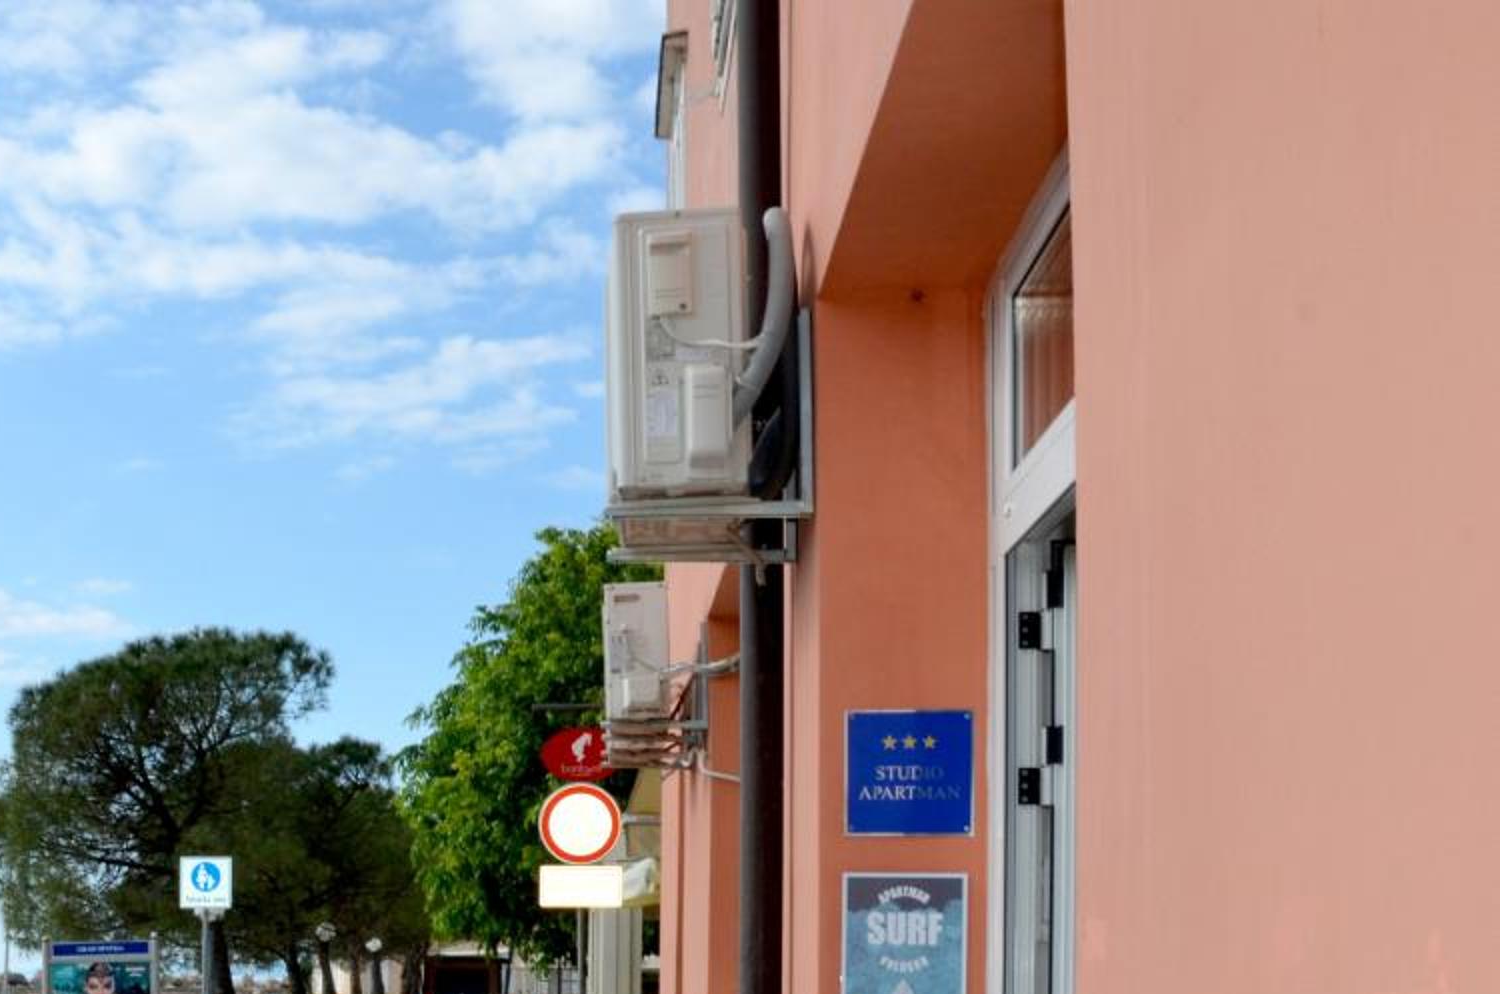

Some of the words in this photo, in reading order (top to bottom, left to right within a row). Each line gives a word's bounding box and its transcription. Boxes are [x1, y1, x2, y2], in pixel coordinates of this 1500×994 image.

[875, 764, 944, 781] STUDIO
[858, 784, 962, 801] APARTMAN
[867, 911, 944, 945] SURF
